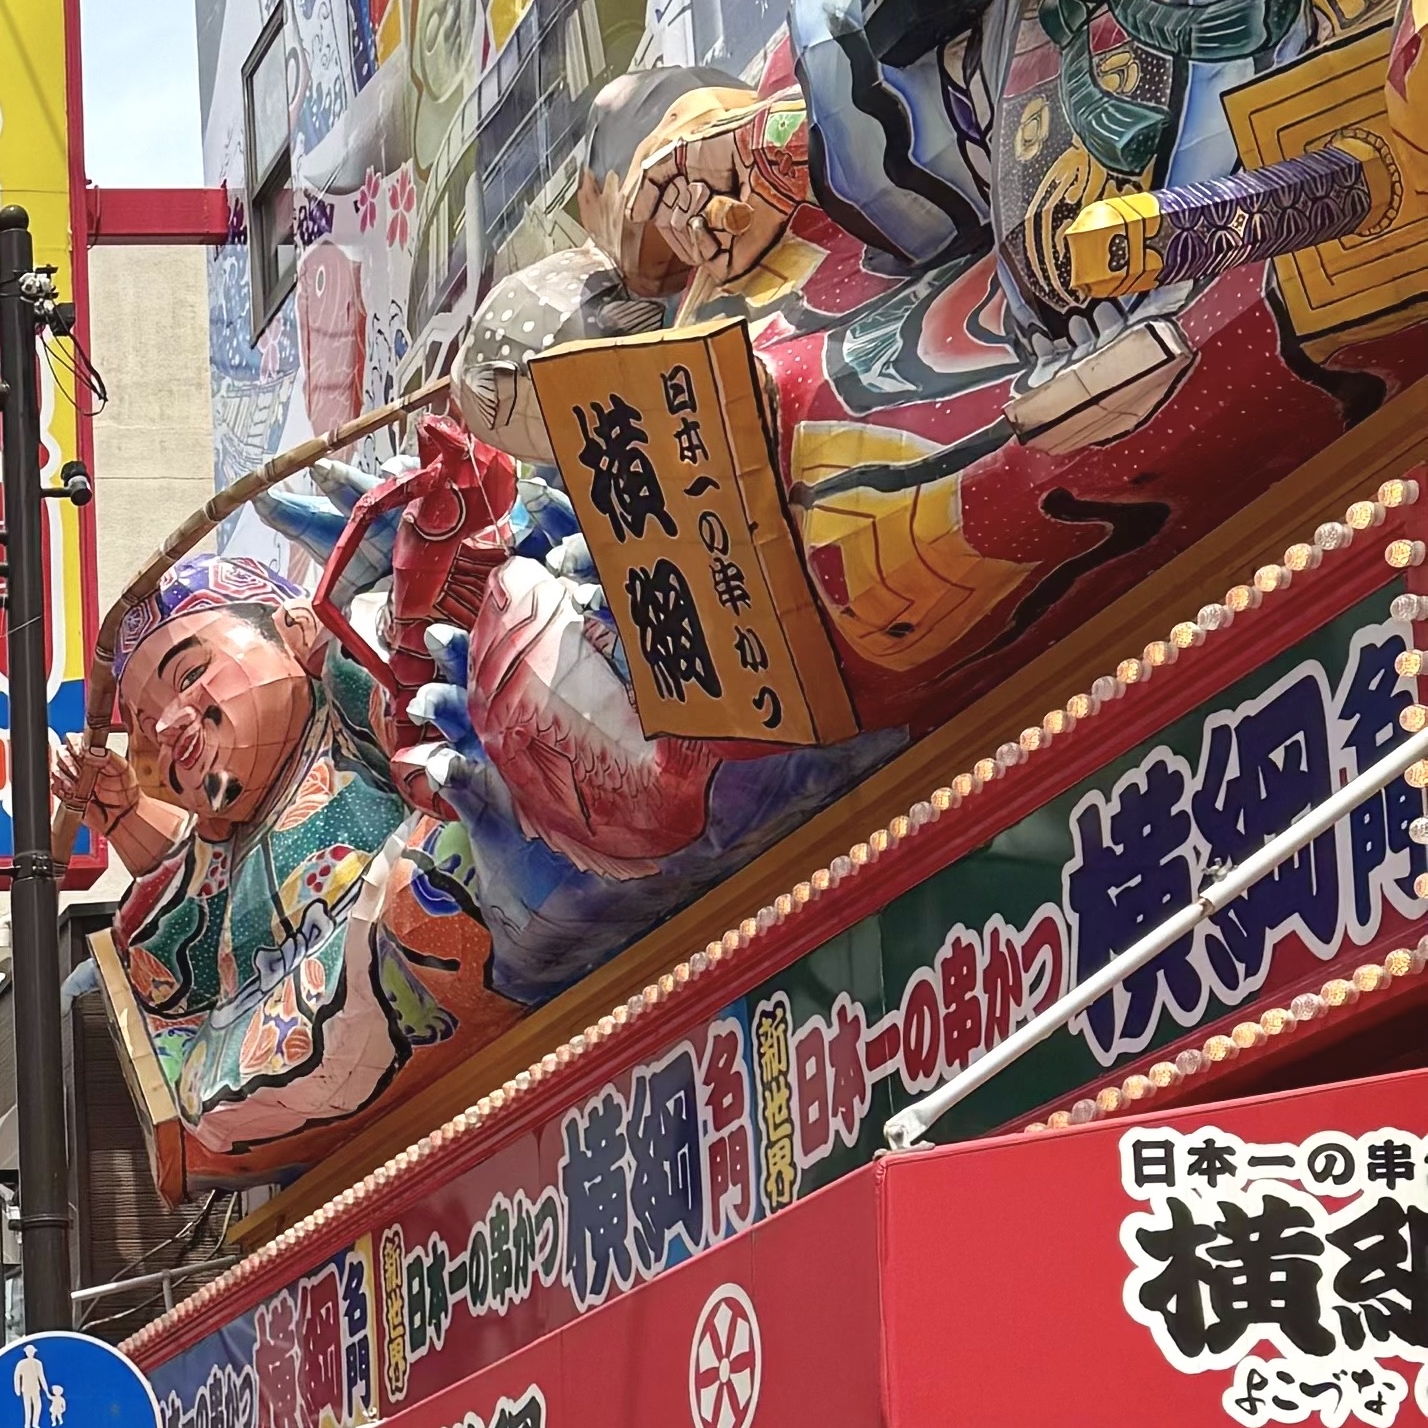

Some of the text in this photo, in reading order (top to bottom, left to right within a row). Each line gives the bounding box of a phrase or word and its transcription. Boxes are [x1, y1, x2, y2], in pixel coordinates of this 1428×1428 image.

[573, 393, 723, 703] 横綱
[409, 1032, 748, 1352] 日本一の串かつ 横綱 名門
[758, 1002, 797, 1207] 新世界
[1132, 1138, 1428, 1188] 日本一の串
[381, 1228, 407, 1395] 新世界
[1234, 1368, 1398, 1416] よこづな
